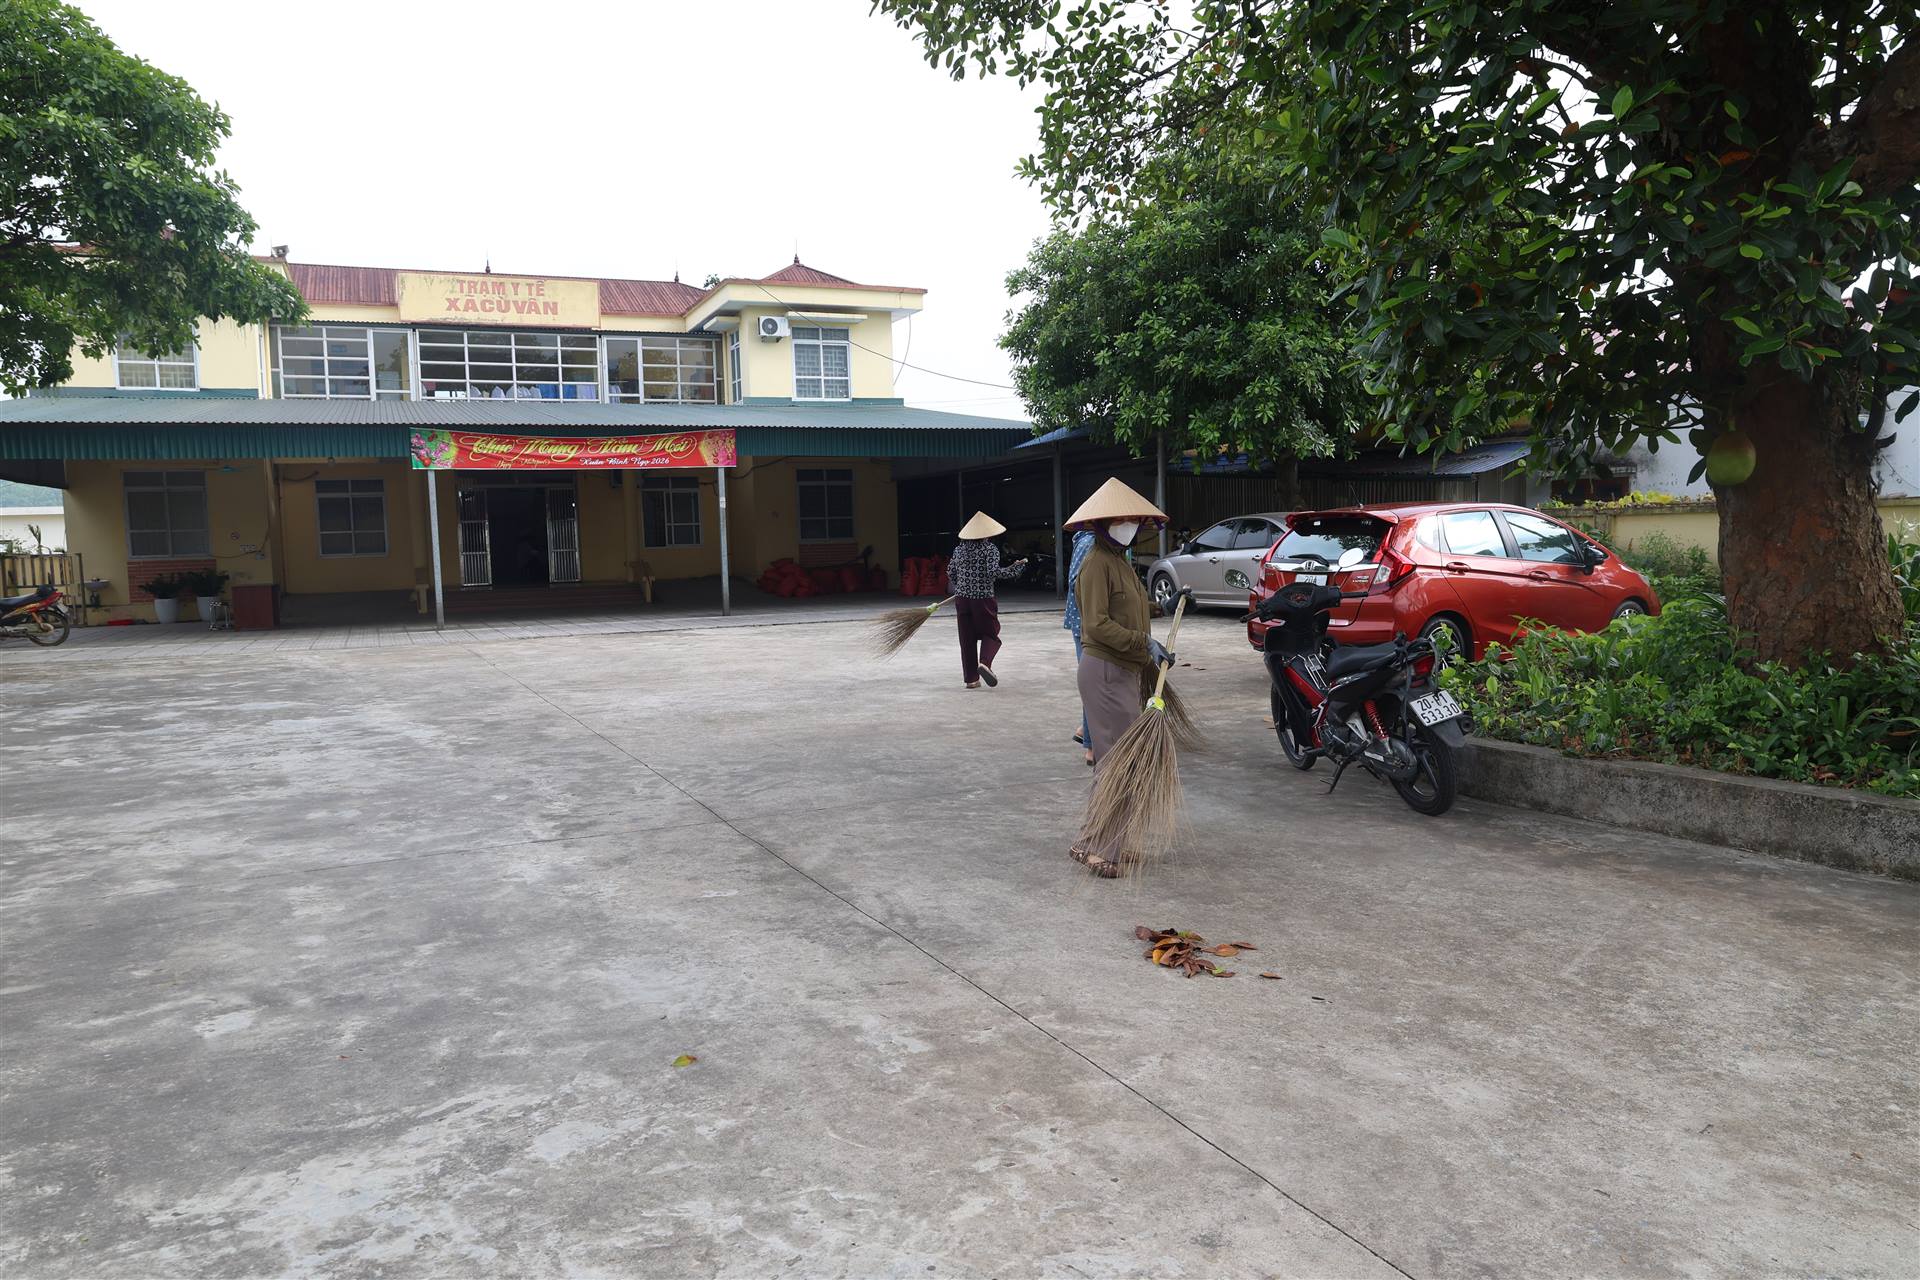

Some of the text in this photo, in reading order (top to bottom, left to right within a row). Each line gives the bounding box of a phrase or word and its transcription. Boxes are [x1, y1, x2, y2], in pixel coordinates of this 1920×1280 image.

[458, 280, 506, 297] TRẠM
[511, 282, 520, 296] Y
[650, 457, 670, 465] 2026
[1421, 703, 1460, 724] 533.30
